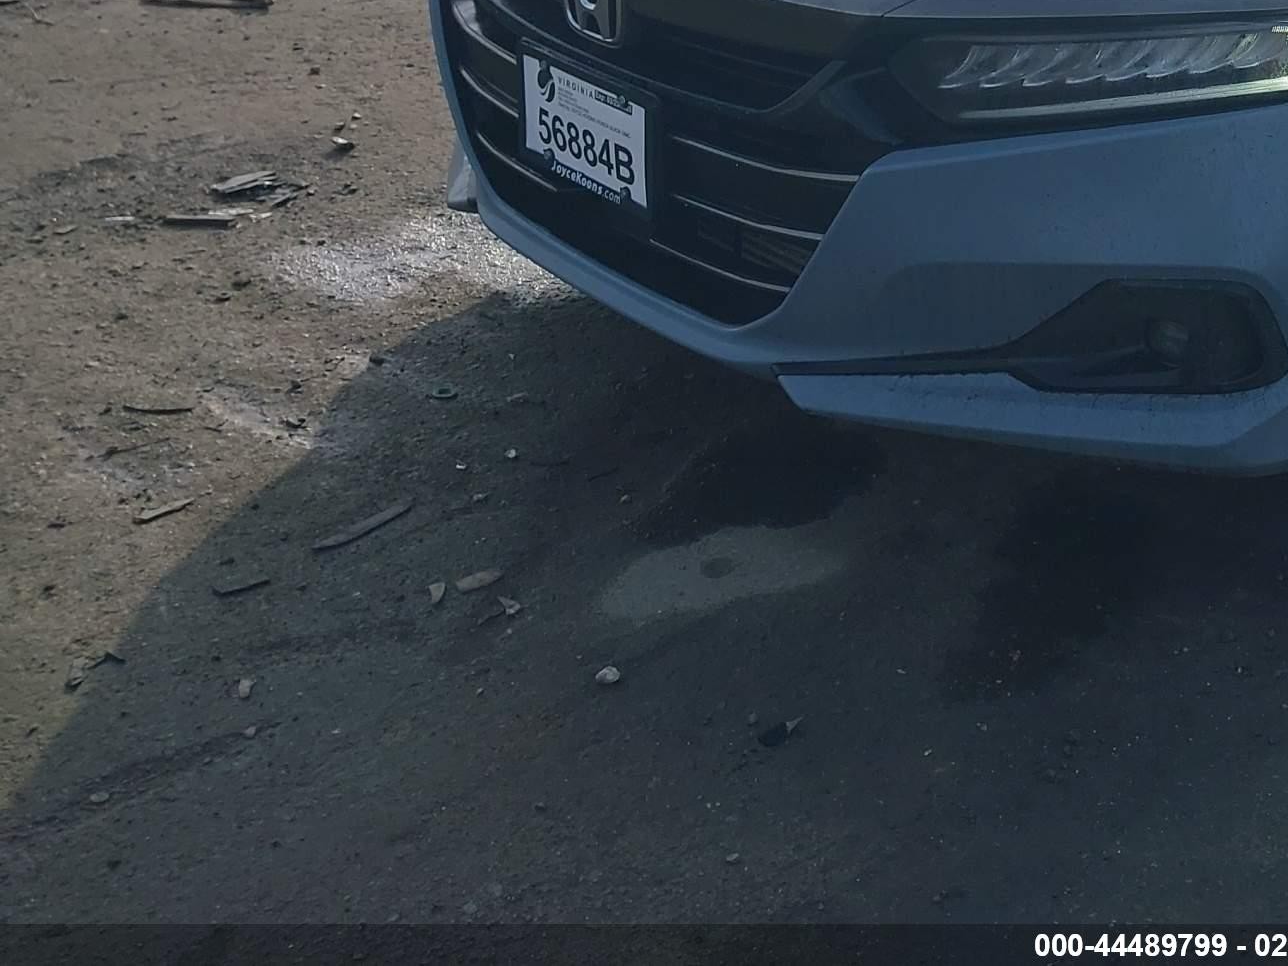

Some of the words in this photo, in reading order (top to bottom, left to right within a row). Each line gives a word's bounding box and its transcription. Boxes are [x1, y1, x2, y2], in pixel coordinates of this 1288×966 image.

[557, 76, 594, 99] VIRGINIA
[538, 106, 635, 185] 56884B
[551, 161, 621, 204] JoyceKoons.com
